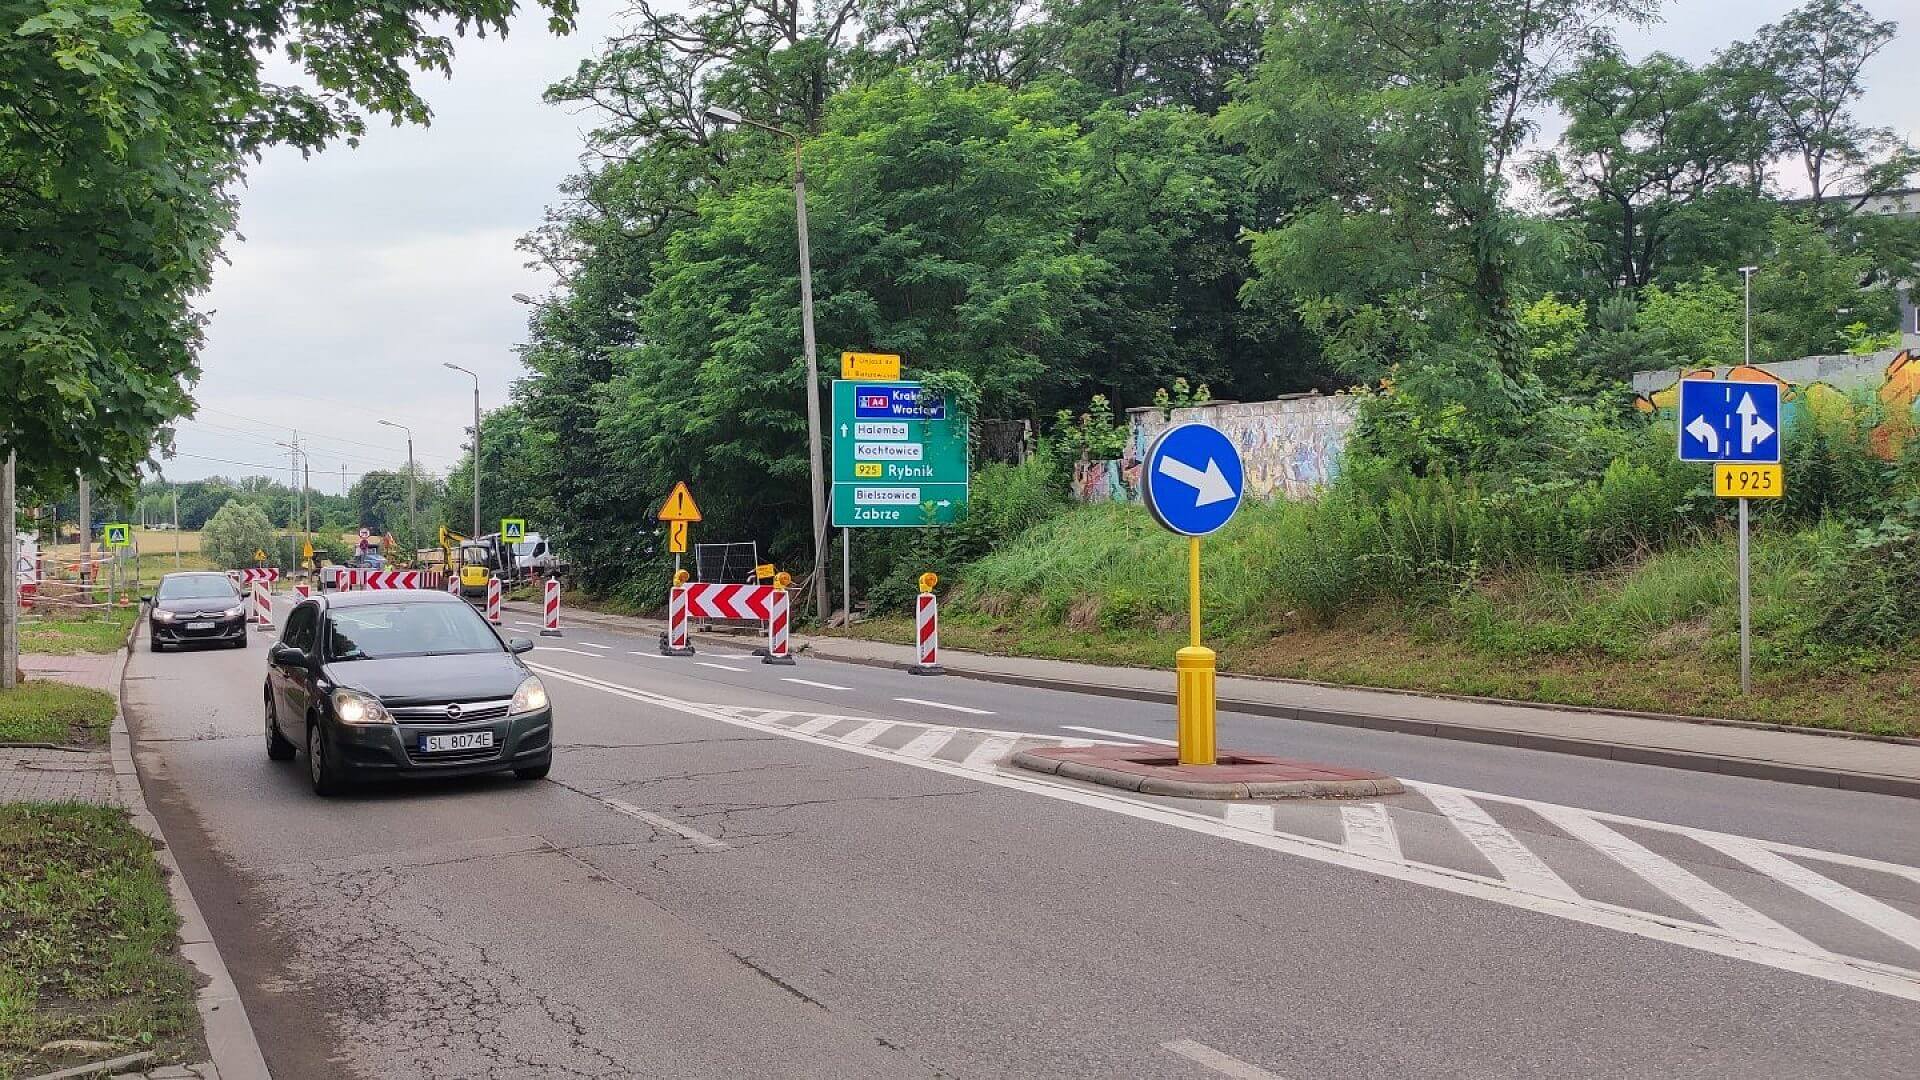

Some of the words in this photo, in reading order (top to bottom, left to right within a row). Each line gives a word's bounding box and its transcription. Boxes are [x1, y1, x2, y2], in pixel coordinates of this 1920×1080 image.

[872, 398, 884, 406] A4
[858, 425, 905, 434] Halemba
[858, 445, 919, 455] Kochłowice
[859, 465, 877, 474] 925
[888, 464, 933, 480] Rybnik
[1739, 471, 1772, 489] 925
[857, 490, 917, 500] Bielszowice
[854, 507, 900, 520] Zabrze
[430, 737, 446, 750] SL
[451, 733, 490, 748] 8074E
